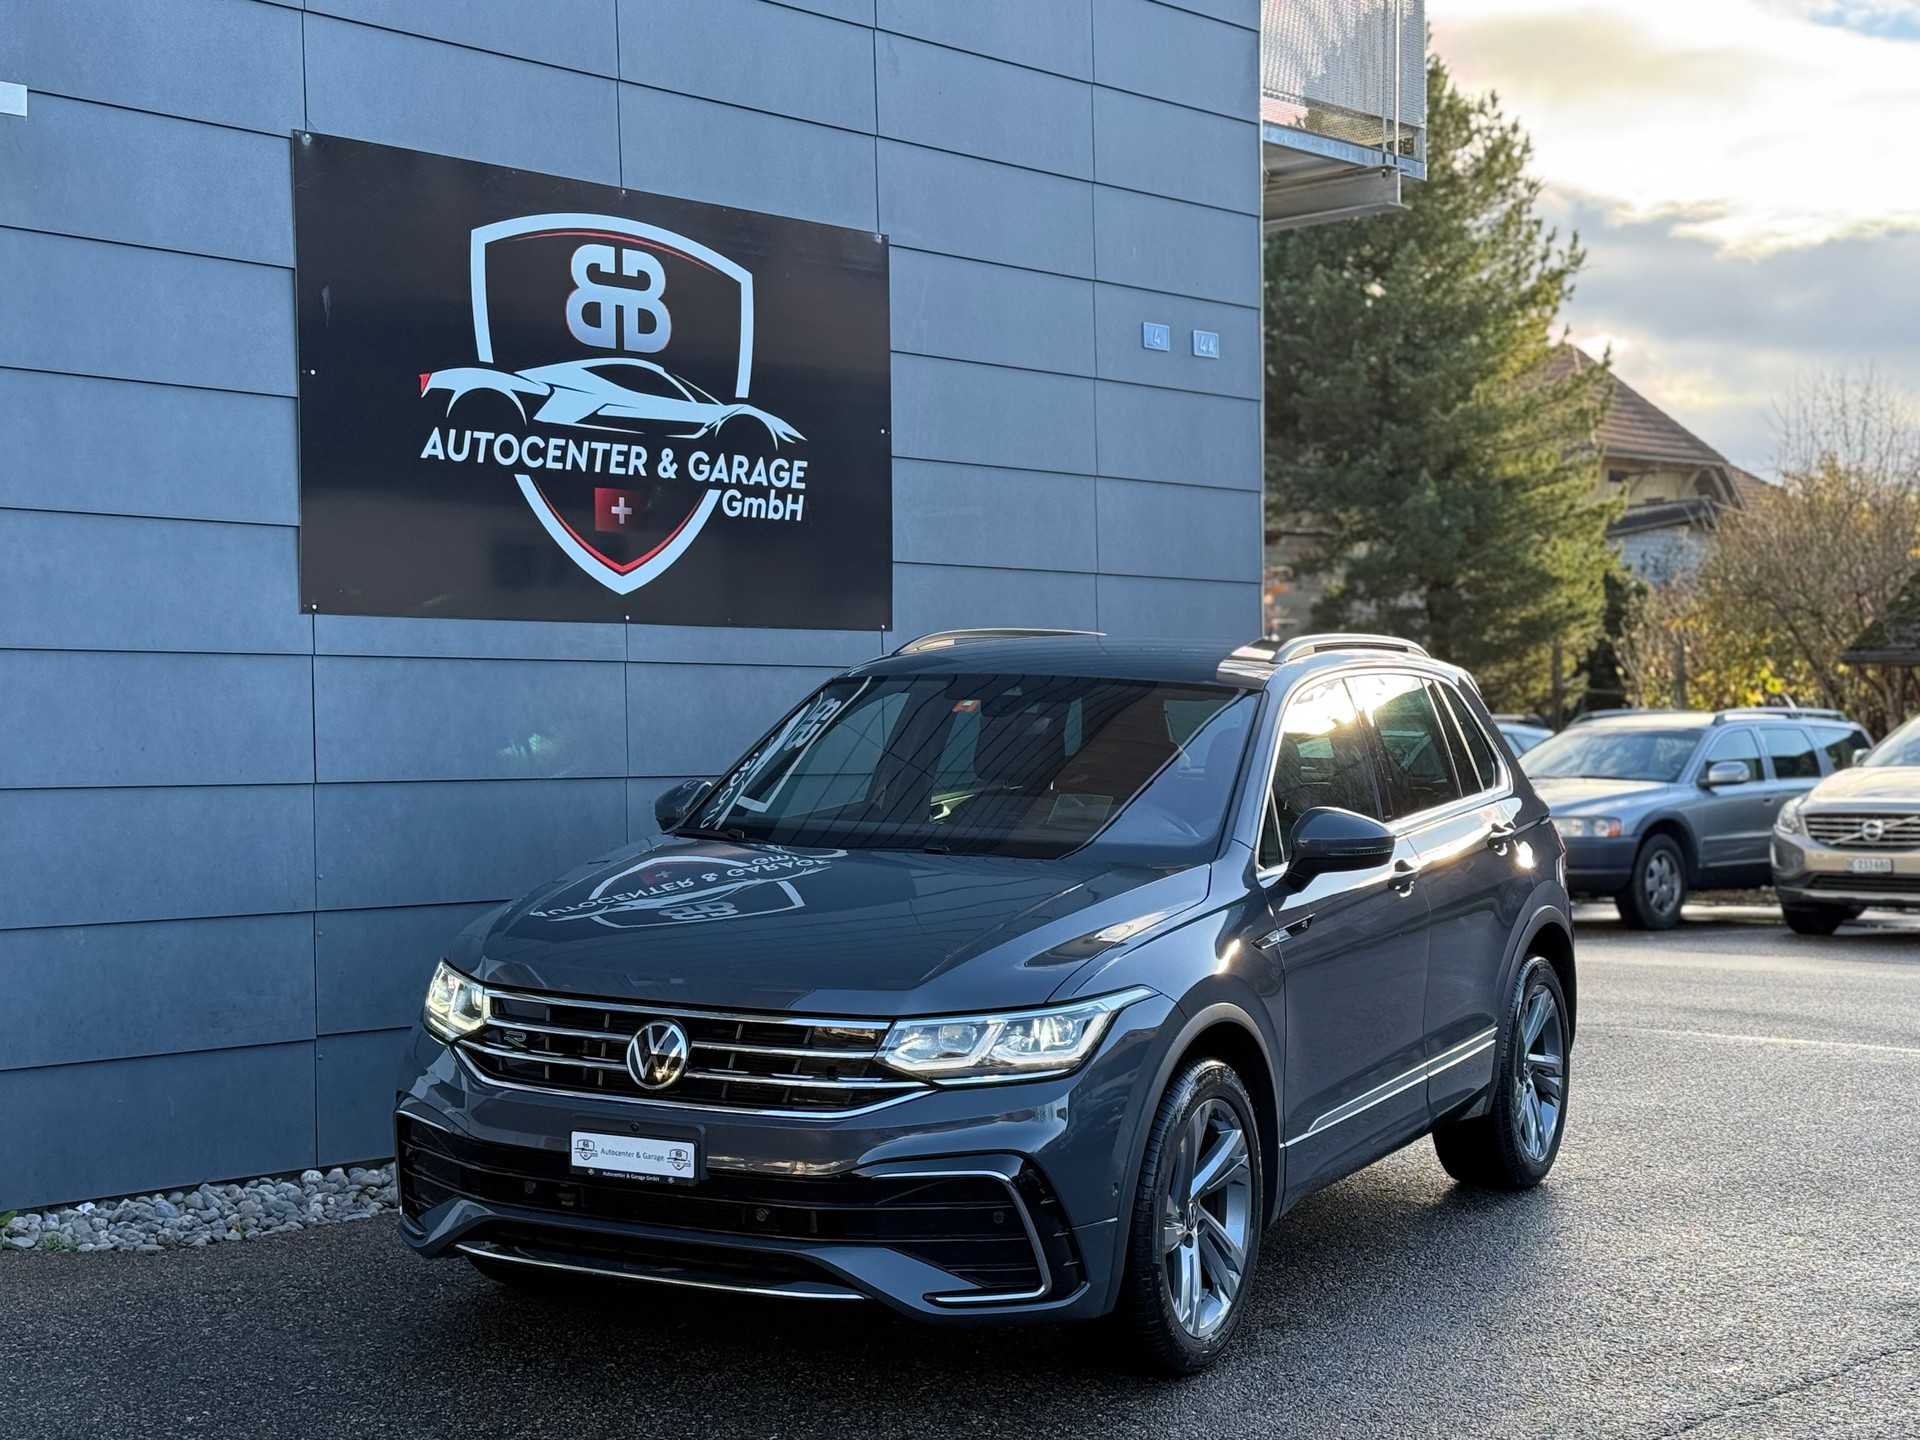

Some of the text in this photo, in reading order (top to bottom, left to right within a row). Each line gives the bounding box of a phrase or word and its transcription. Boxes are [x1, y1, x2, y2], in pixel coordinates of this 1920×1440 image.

[1153, 327, 1161, 346] 4
[420, 426, 809, 490] AUTOCENTER & GARAGE
[721, 489, 805, 522] GmbH
[600, 1148, 635, 1158] Autocenter
[636, 1151, 641, 1159] &
[642, 1152, 665, 1162] Garage
[602, 1171, 626, 1179] Autocenter
[631, 1173, 646, 1181] Garage
